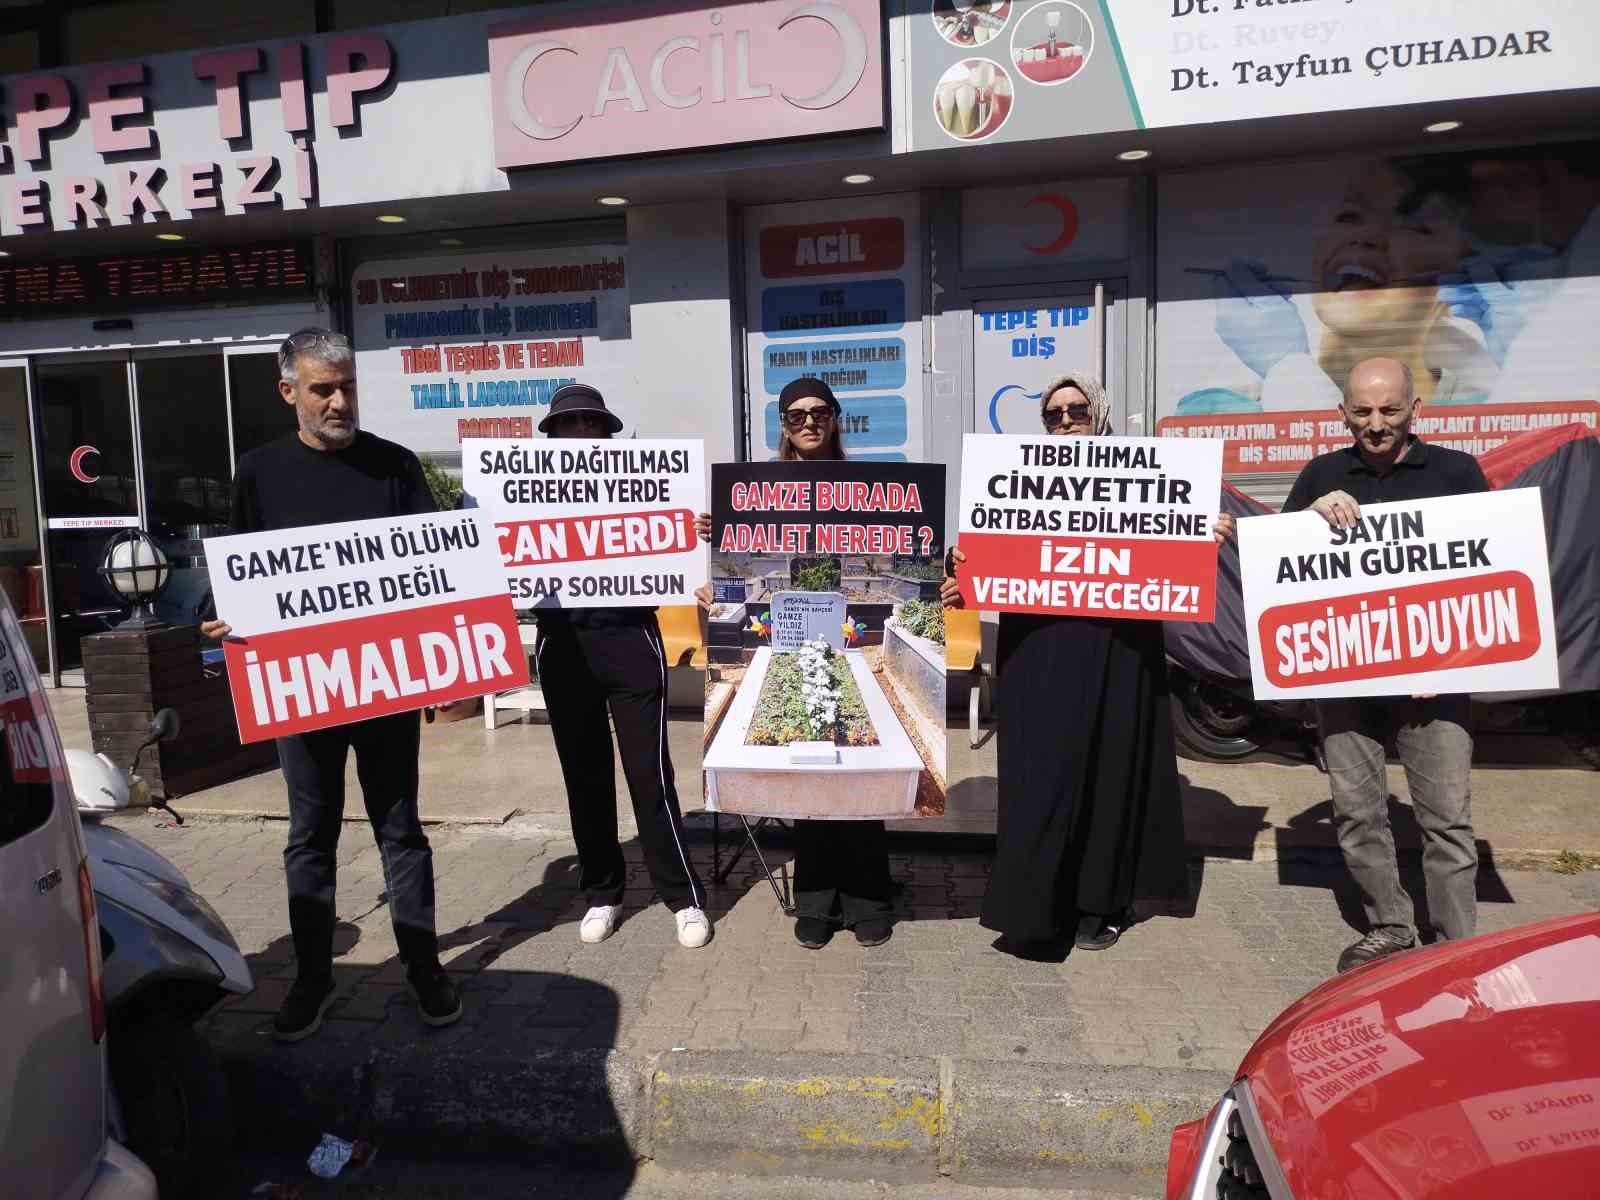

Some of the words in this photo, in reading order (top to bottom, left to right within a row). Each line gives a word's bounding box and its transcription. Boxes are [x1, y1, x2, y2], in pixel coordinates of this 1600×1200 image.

[590, 12, 773, 118] ACİL
[1170, 67, 1219, 91] Dt.
[1233, 54, 1352, 88] Tayfun
[1365, 30, 1551, 77] ÇUHADAR
[0, 62, 158, 168] PE
[193, 33, 397, 146] TIP
[6, 137, 316, 228] ERKEZİ
[796, 228, 866, 267] ACİL
[979, 309, 1038, 332] TEPE
[1047, 306, 1089, 328] TIP
[445, 340, 500, 374] TEŞHİS
[503, 344, 524, 369] VE
[527, 335, 584, 368] TEDAVİ
[1012, 333, 1056, 359] DİŞ
[411, 378, 465, 410] TAHLİL
[479, 445, 555, 475] SAĞLIK
[560, 445, 689, 474] DAĞITILMASI
[1020, 441, 1081, 468] TIBBİ
[1087, 441, 1161, 469] İHMAL
[1239, 443, 1263, 464] DİŞ
[503, 479, 599, 504] GEREKEN
[604, 478, 670, 503] YERDE
[731, 481, 811, 512] GAMZE
[816, 481, 923, 513] BURADA
[987, 470, 1192, 505] CİNAYETTİR
[574, 512, 687, 558] VERDİ
[970, 503, 1062, 532] ÖRTBAS
[1068, 507, 1207, 537] EDİLMESİNE
[1330, 510, 1425, 546] SAYIN
[226, 532, 384, 582] GAMZE'NİN
[390, 518, 480, 559] ÖLÜMÜ
[719, 523, 811, 553] ADALET
[815, 524, 913, 555] NEREDE
[918, 526, 934, 556] ?
[1040, 540, 1132, 576] İZİN
[1275, 551, 1352, 584] AKIN
[1360, 538, 1492, 577] GÜRLEK
[276, 580, 374, 620] KADER
[379, 565, 456, 604] DEĞİL
[507, 576, 563, 599] ESAP
[568, 574, 685, 597] SORULSUN
[972, 576, 1200, 614] VERMEYECEĞİZ!
[778, 612, 803, 621] GAMZE
[1275, 595, 1402, 678] SESİMİZİ
[1406, 587, 1520, 659] DUYUN
[244, 614, 514, 726] İHMALDİR
